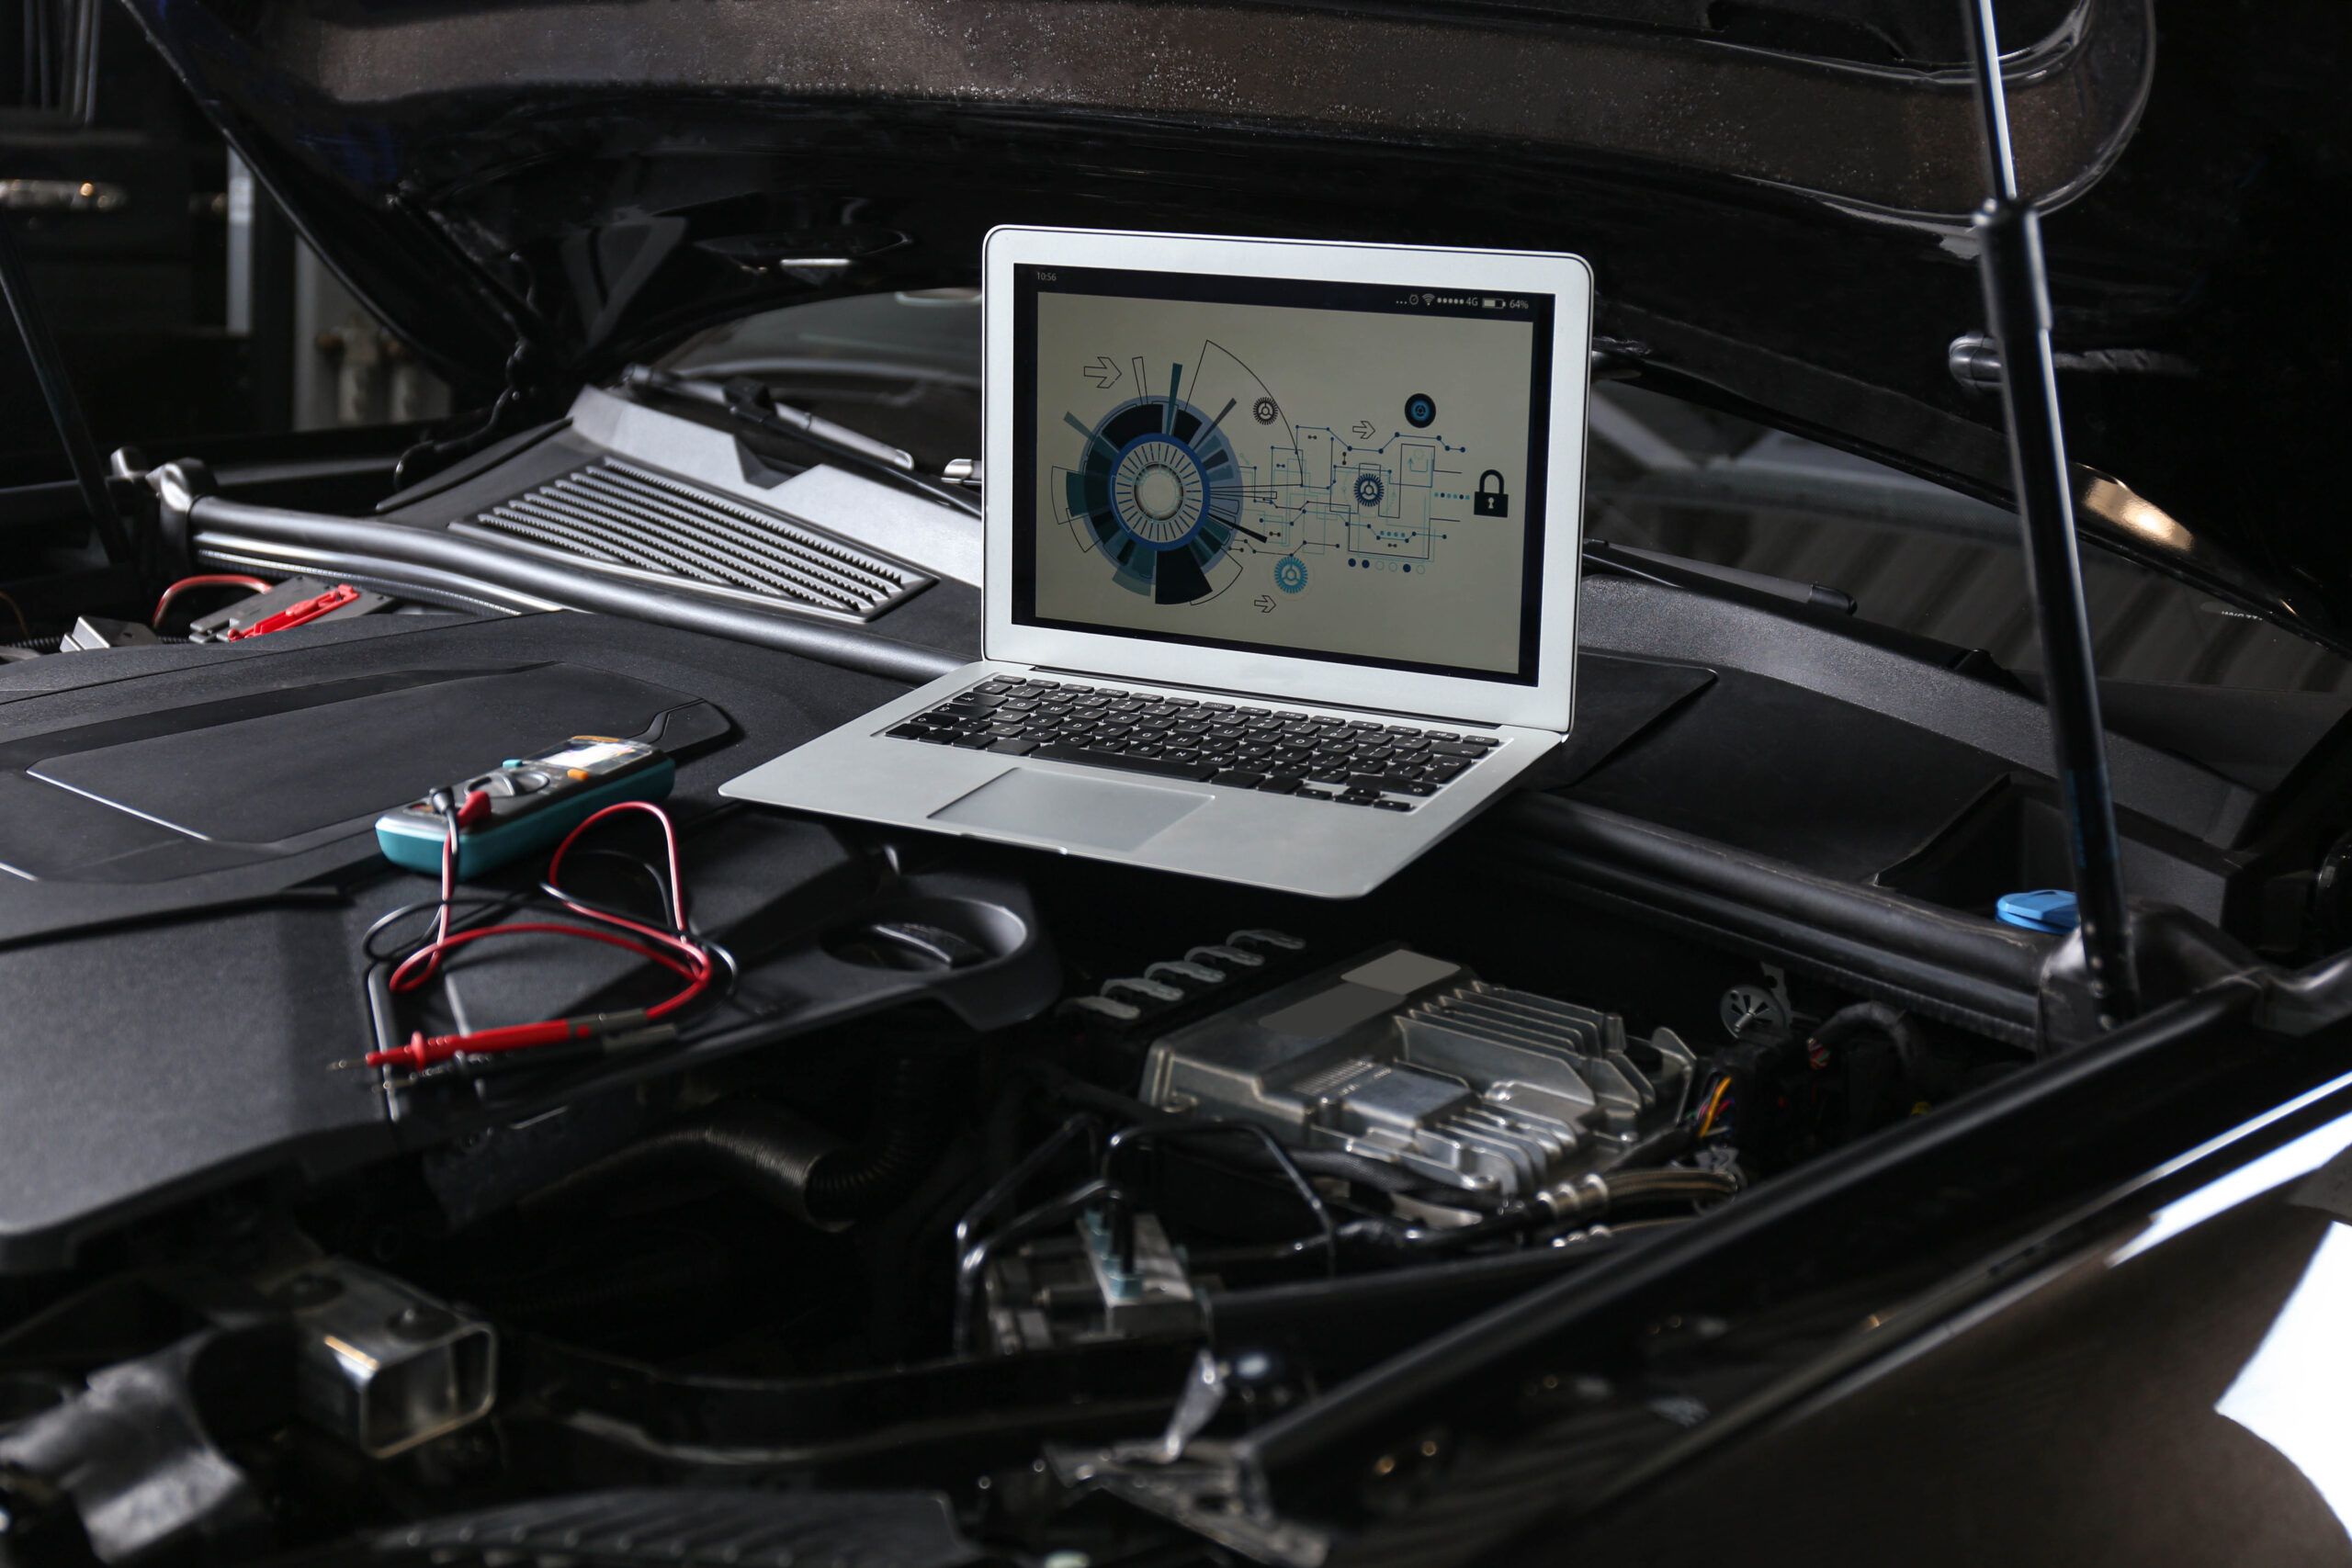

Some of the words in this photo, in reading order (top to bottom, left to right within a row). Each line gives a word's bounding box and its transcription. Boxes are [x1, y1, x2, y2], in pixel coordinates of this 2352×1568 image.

[1036, 271, 1057, 281] 10:56
[1465, 297, 1478, 306] 4G
[1510, 299, 1529, 309] 64%
